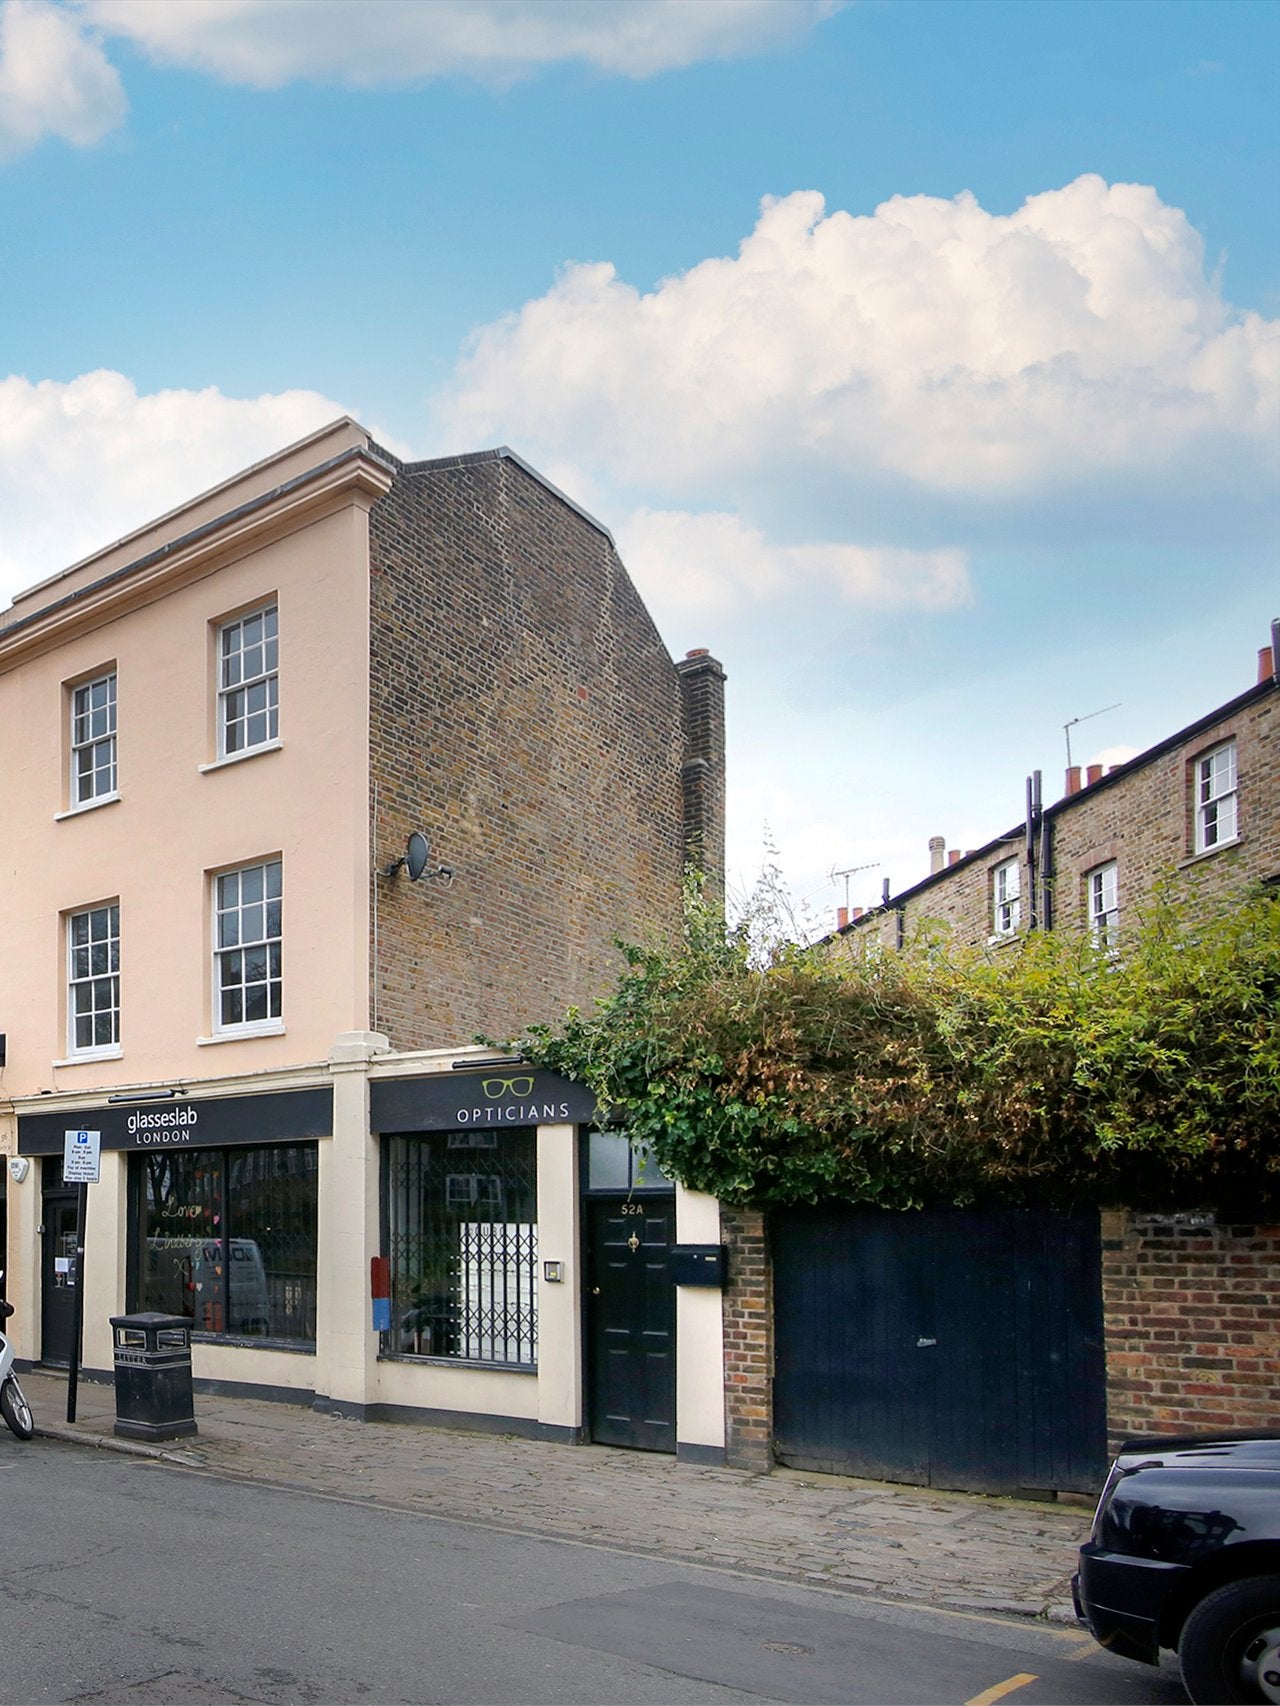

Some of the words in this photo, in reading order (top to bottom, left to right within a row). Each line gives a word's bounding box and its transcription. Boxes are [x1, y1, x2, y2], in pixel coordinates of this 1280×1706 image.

[128, 1106, 197, 1133] glasseslab
[457, 1103, 569, 1123] OPTICIANS
[136, 1130, 189, 1144] LONDON
[162, 1194, 201, 1218] Love
[621, 1204, 644, 1215] 52A
